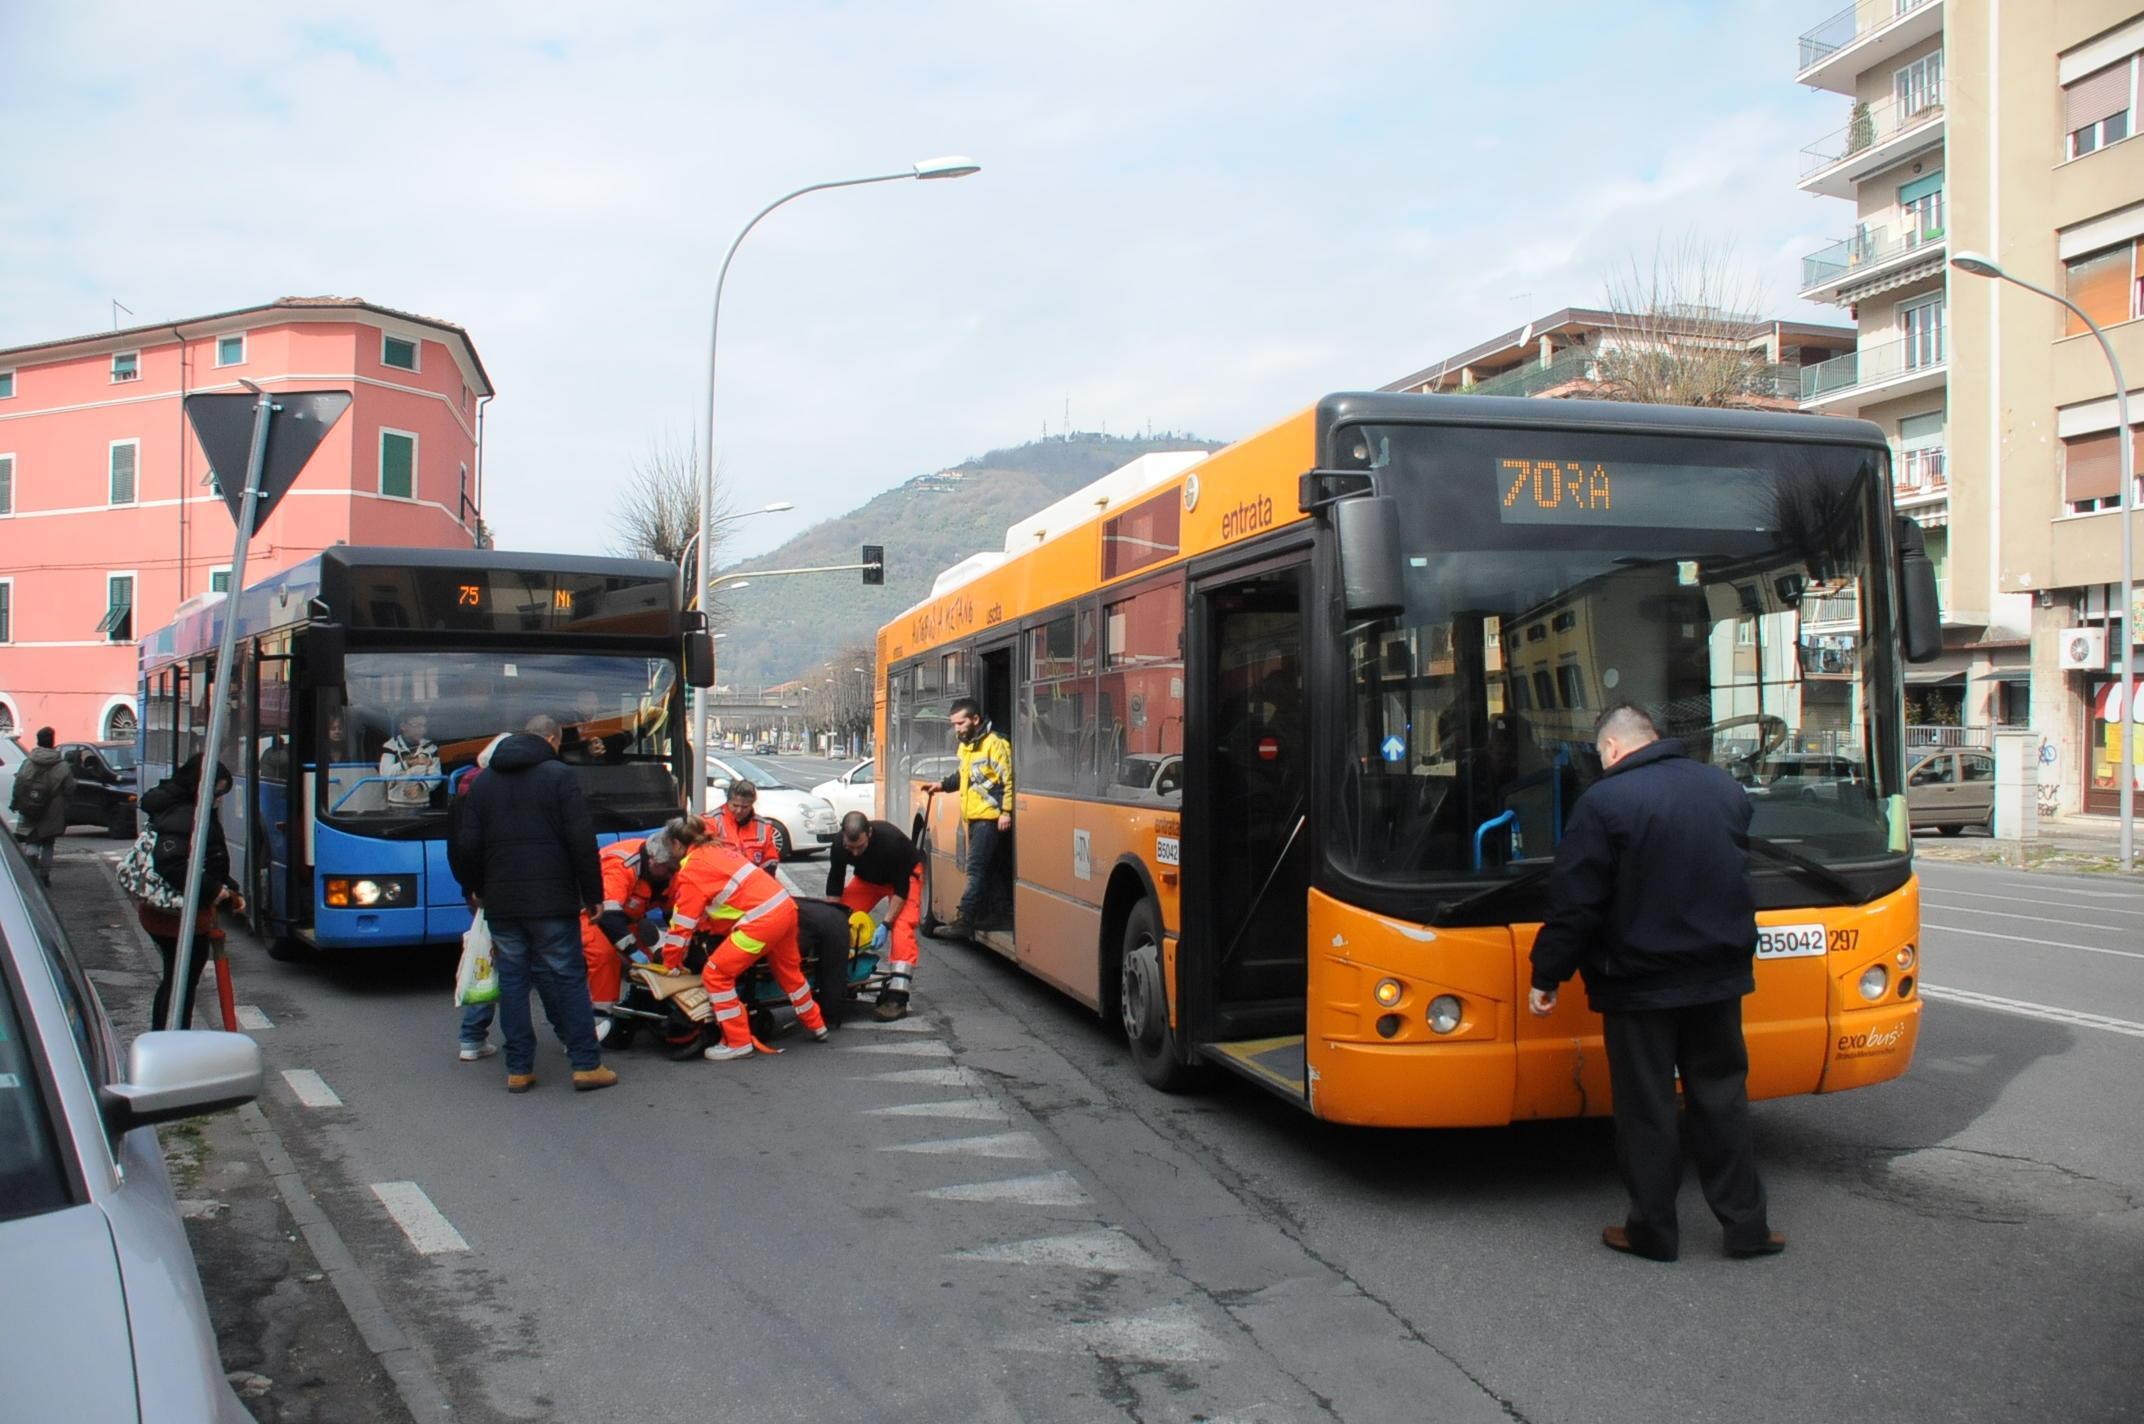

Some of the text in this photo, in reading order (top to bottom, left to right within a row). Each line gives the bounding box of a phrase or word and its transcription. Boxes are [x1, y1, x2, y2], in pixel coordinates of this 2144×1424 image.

[1222, 493, 1272, 540] entrata
[459, 586, 480, 606] 75
[1157, 841, 1178, 861] B5042
[1759, 931, 1823, 953] B5042
[1829, 929, 1859, 952] 297
[1838, 1026, 1899, 1050] exobus
